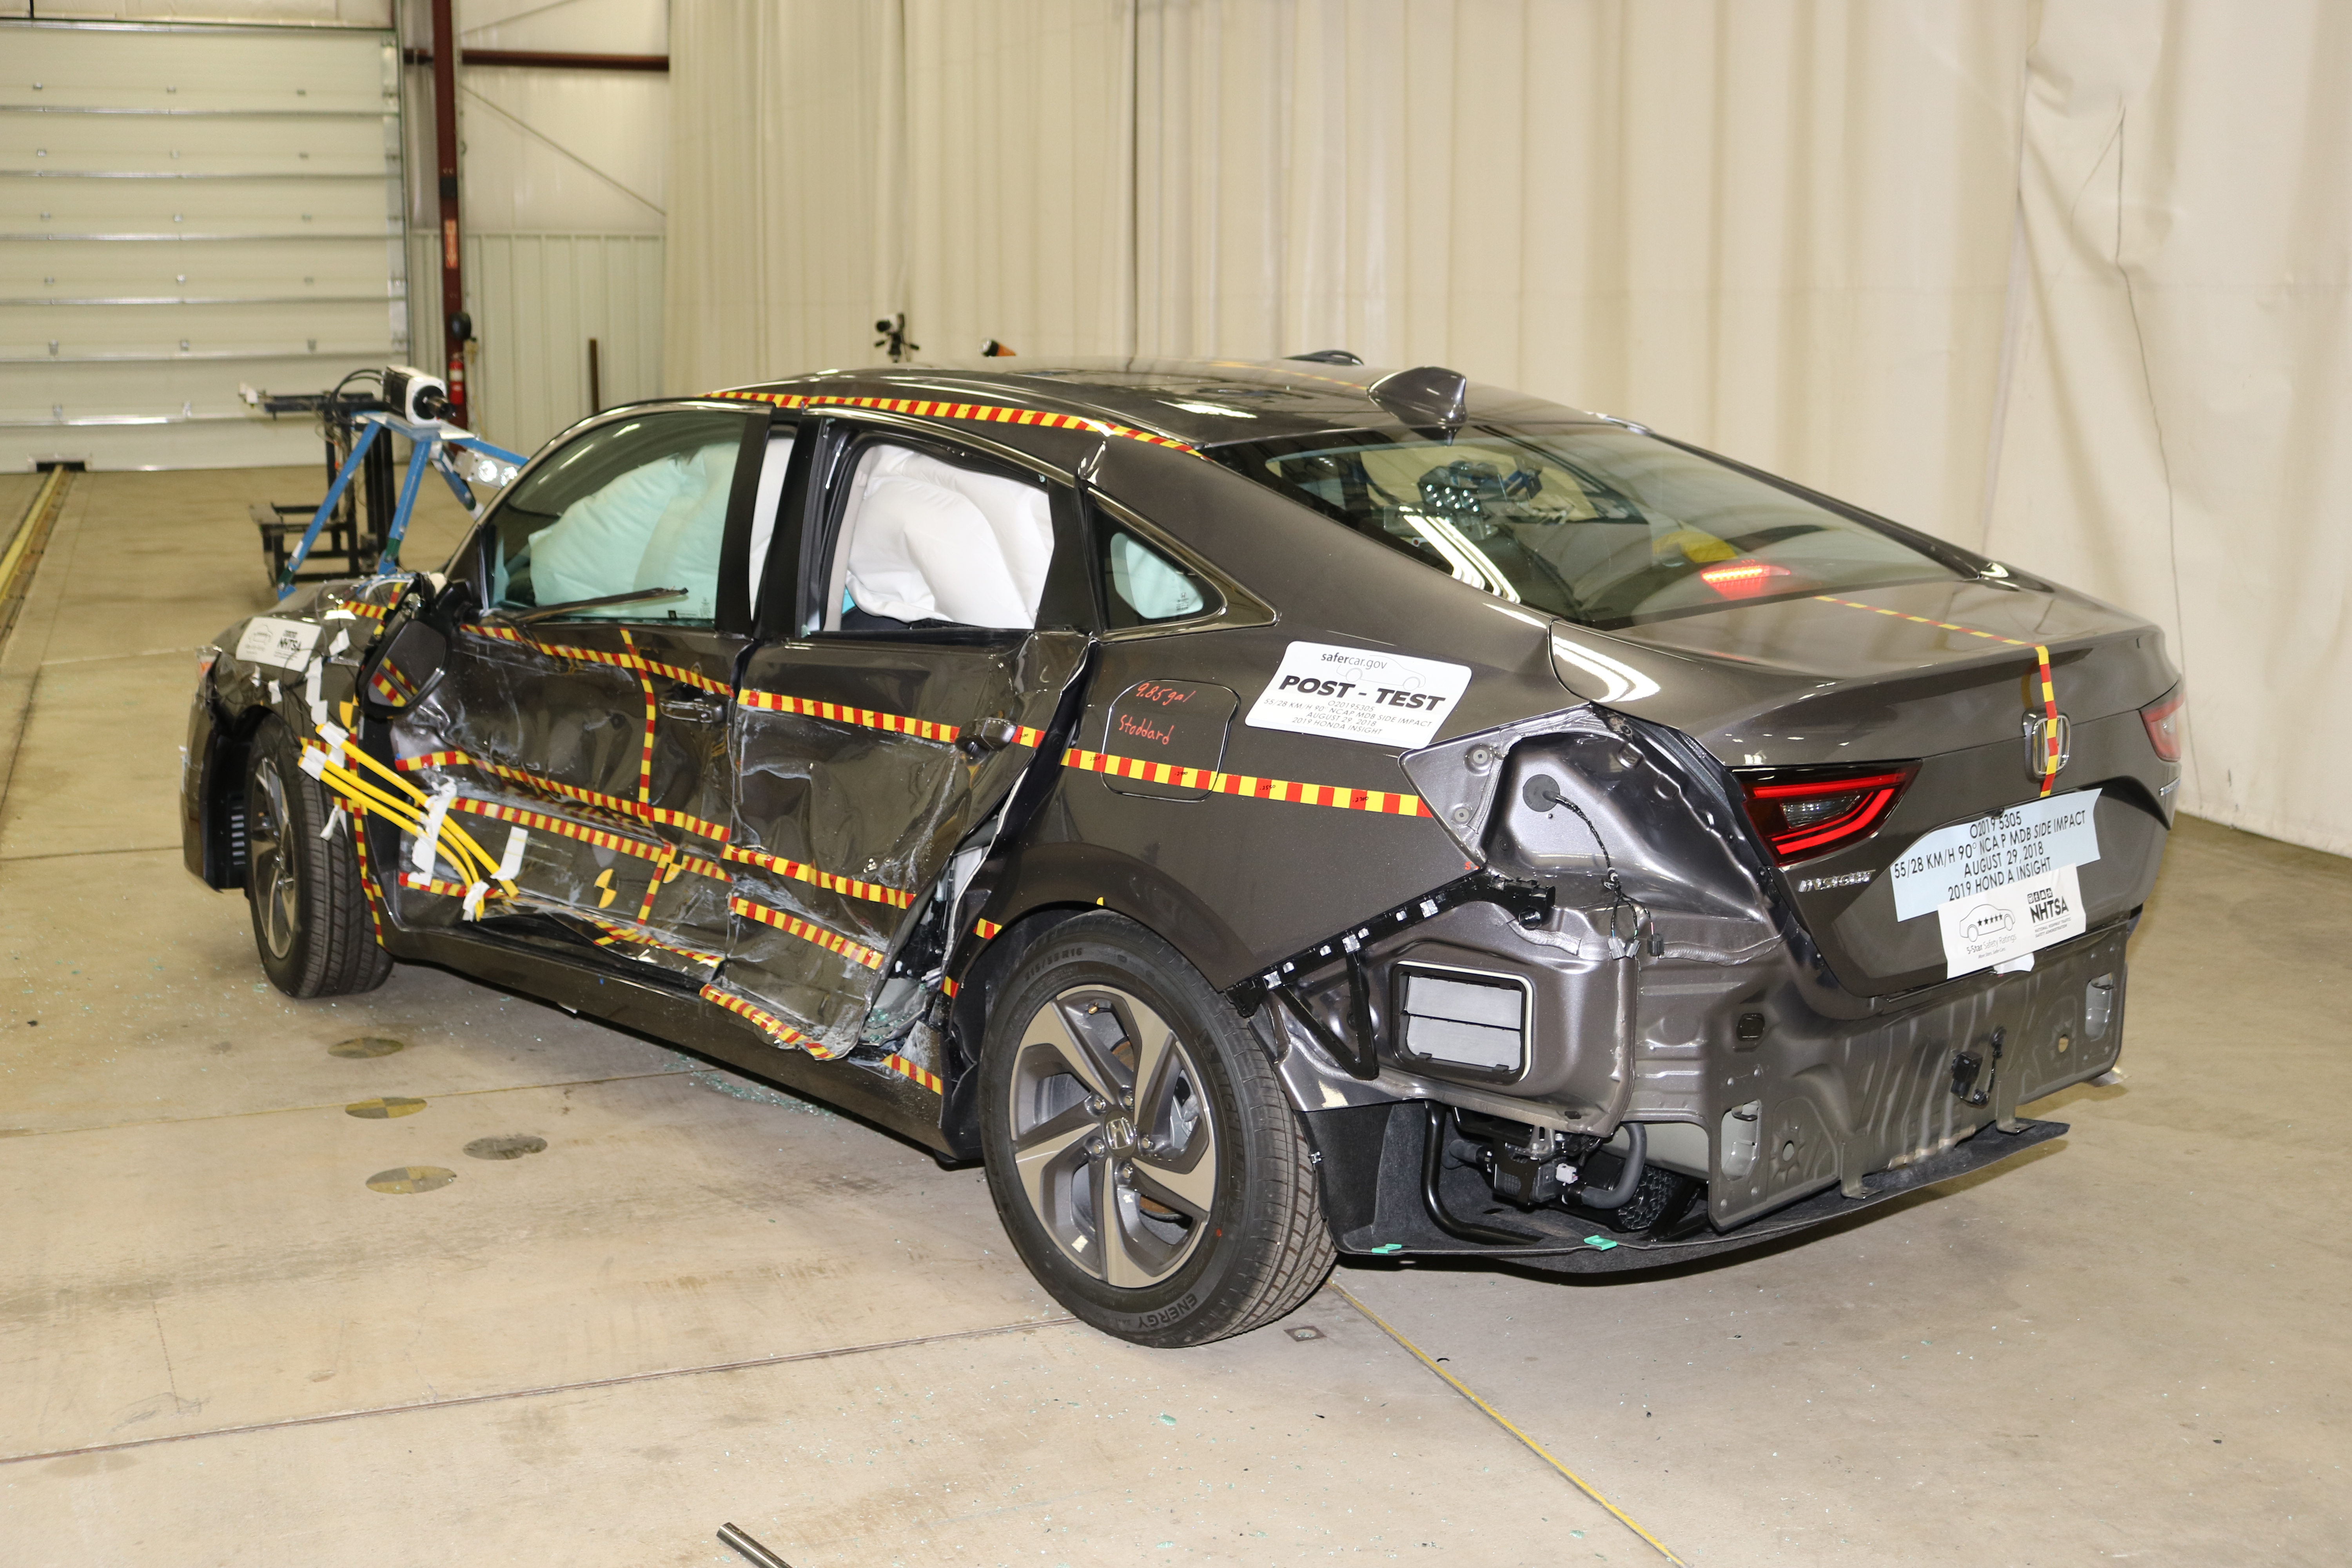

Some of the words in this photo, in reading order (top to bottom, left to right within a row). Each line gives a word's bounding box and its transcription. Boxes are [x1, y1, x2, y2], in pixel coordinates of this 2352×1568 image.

[1321, 652, 1388, 670] safercar.gov
[1278, 675, 1356, 698] POST
[1375, 688, 1446, 711] TEST
[1263, 698, 1287, 707] 55/28
[1328, 708, 1355, 716] NCAP
[1356, 711, 1376, 720] MDB
[1397, 717, 1433, 727] IMPACT
[1306, 712, 1340, 721] AUGUST
[1314, 720, 1345, 730] HONDA
[1347, 725, 1383, 735] INSIGHT
[1119, 714, 1175, 745] Stoddard
[1895, 857, 1924, 879] 55/28
[1926, 848, 1956, 870] KM/H
[2010, 827, 2031, 846] MDB
[2034, 820, 2052, 839] SIDE
[2054, 810, 2086, 833] IMPACT
[1964, 852, 2002, 878] AUGUST
[2023, 841, 2044, 860] 2018
[1948, 881, 1971, 902] 2019
[2016, 857, 2051, 881] INSIGHT
[2029, 895, 2069, 924] NHTSA
[1966, 944, 1983, 955] 5-Star
[1983, 939, 1998, 949] Safety
[1999, 934, 2017, 945] Ratings
[1138, 1294, 1198, 1328] ENERGY
